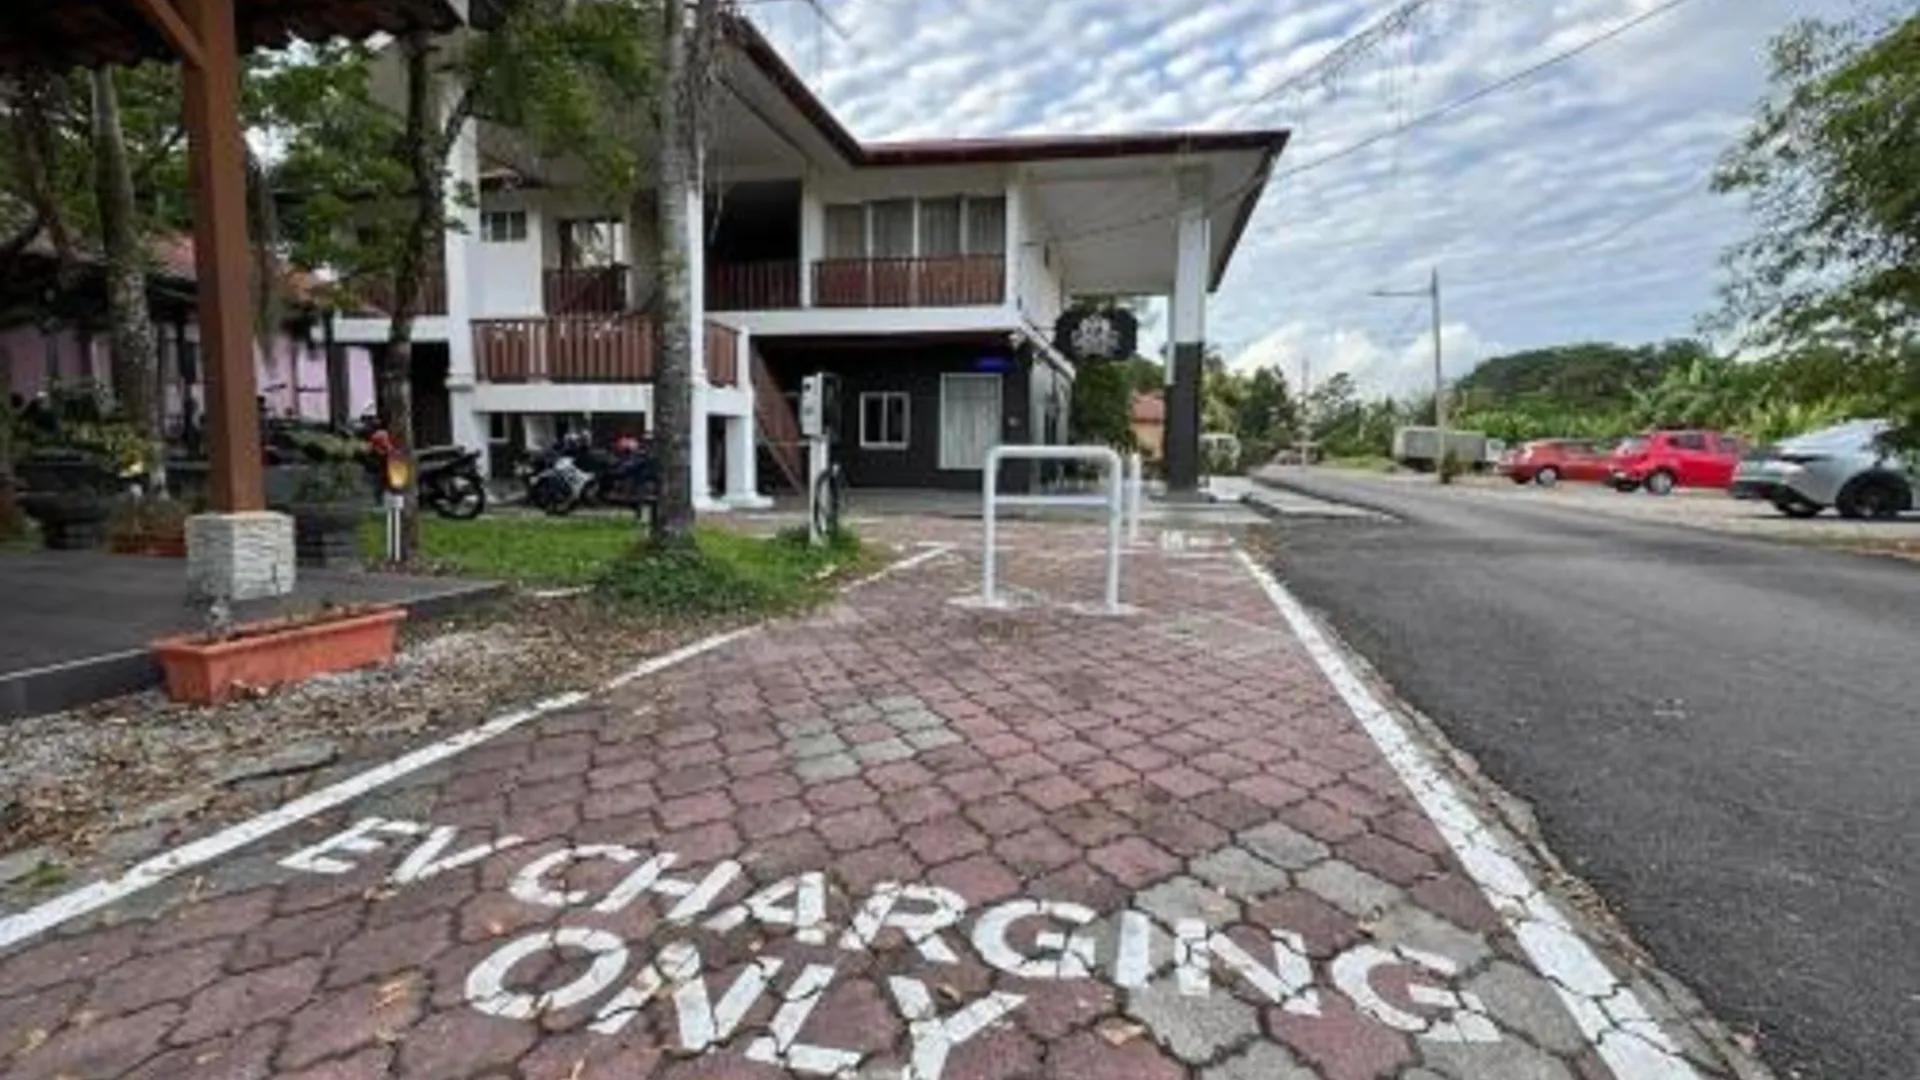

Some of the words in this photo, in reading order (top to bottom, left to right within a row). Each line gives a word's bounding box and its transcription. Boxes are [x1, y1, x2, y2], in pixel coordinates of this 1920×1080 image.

[278, 816, 524, 883] EV
[508, 844, 1501, 1041] CHARGING
[464, 928, 1027, 1080] ONLY
